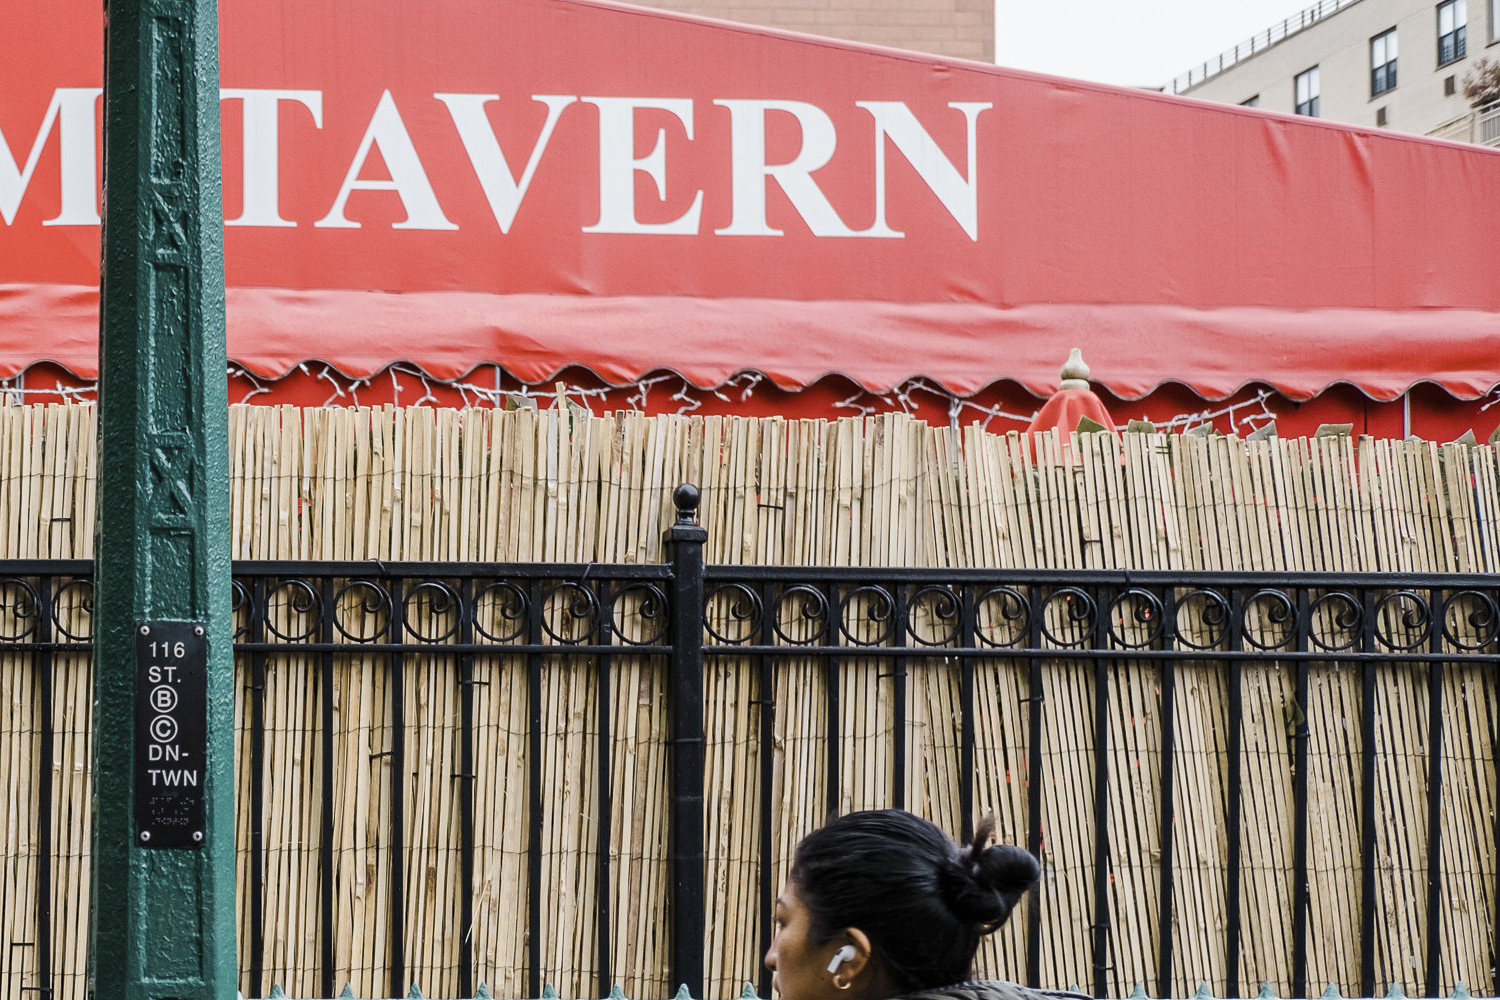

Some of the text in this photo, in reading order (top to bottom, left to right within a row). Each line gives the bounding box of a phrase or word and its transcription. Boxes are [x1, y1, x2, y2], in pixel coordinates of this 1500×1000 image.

[219, 88, 993, 242] TAVERN
[149, 641, 186, 659] 116
[148, 665, 182, 684] ST.
[148, 744, 189, 762] DN-
[147, 769, 197, 787] TWN
